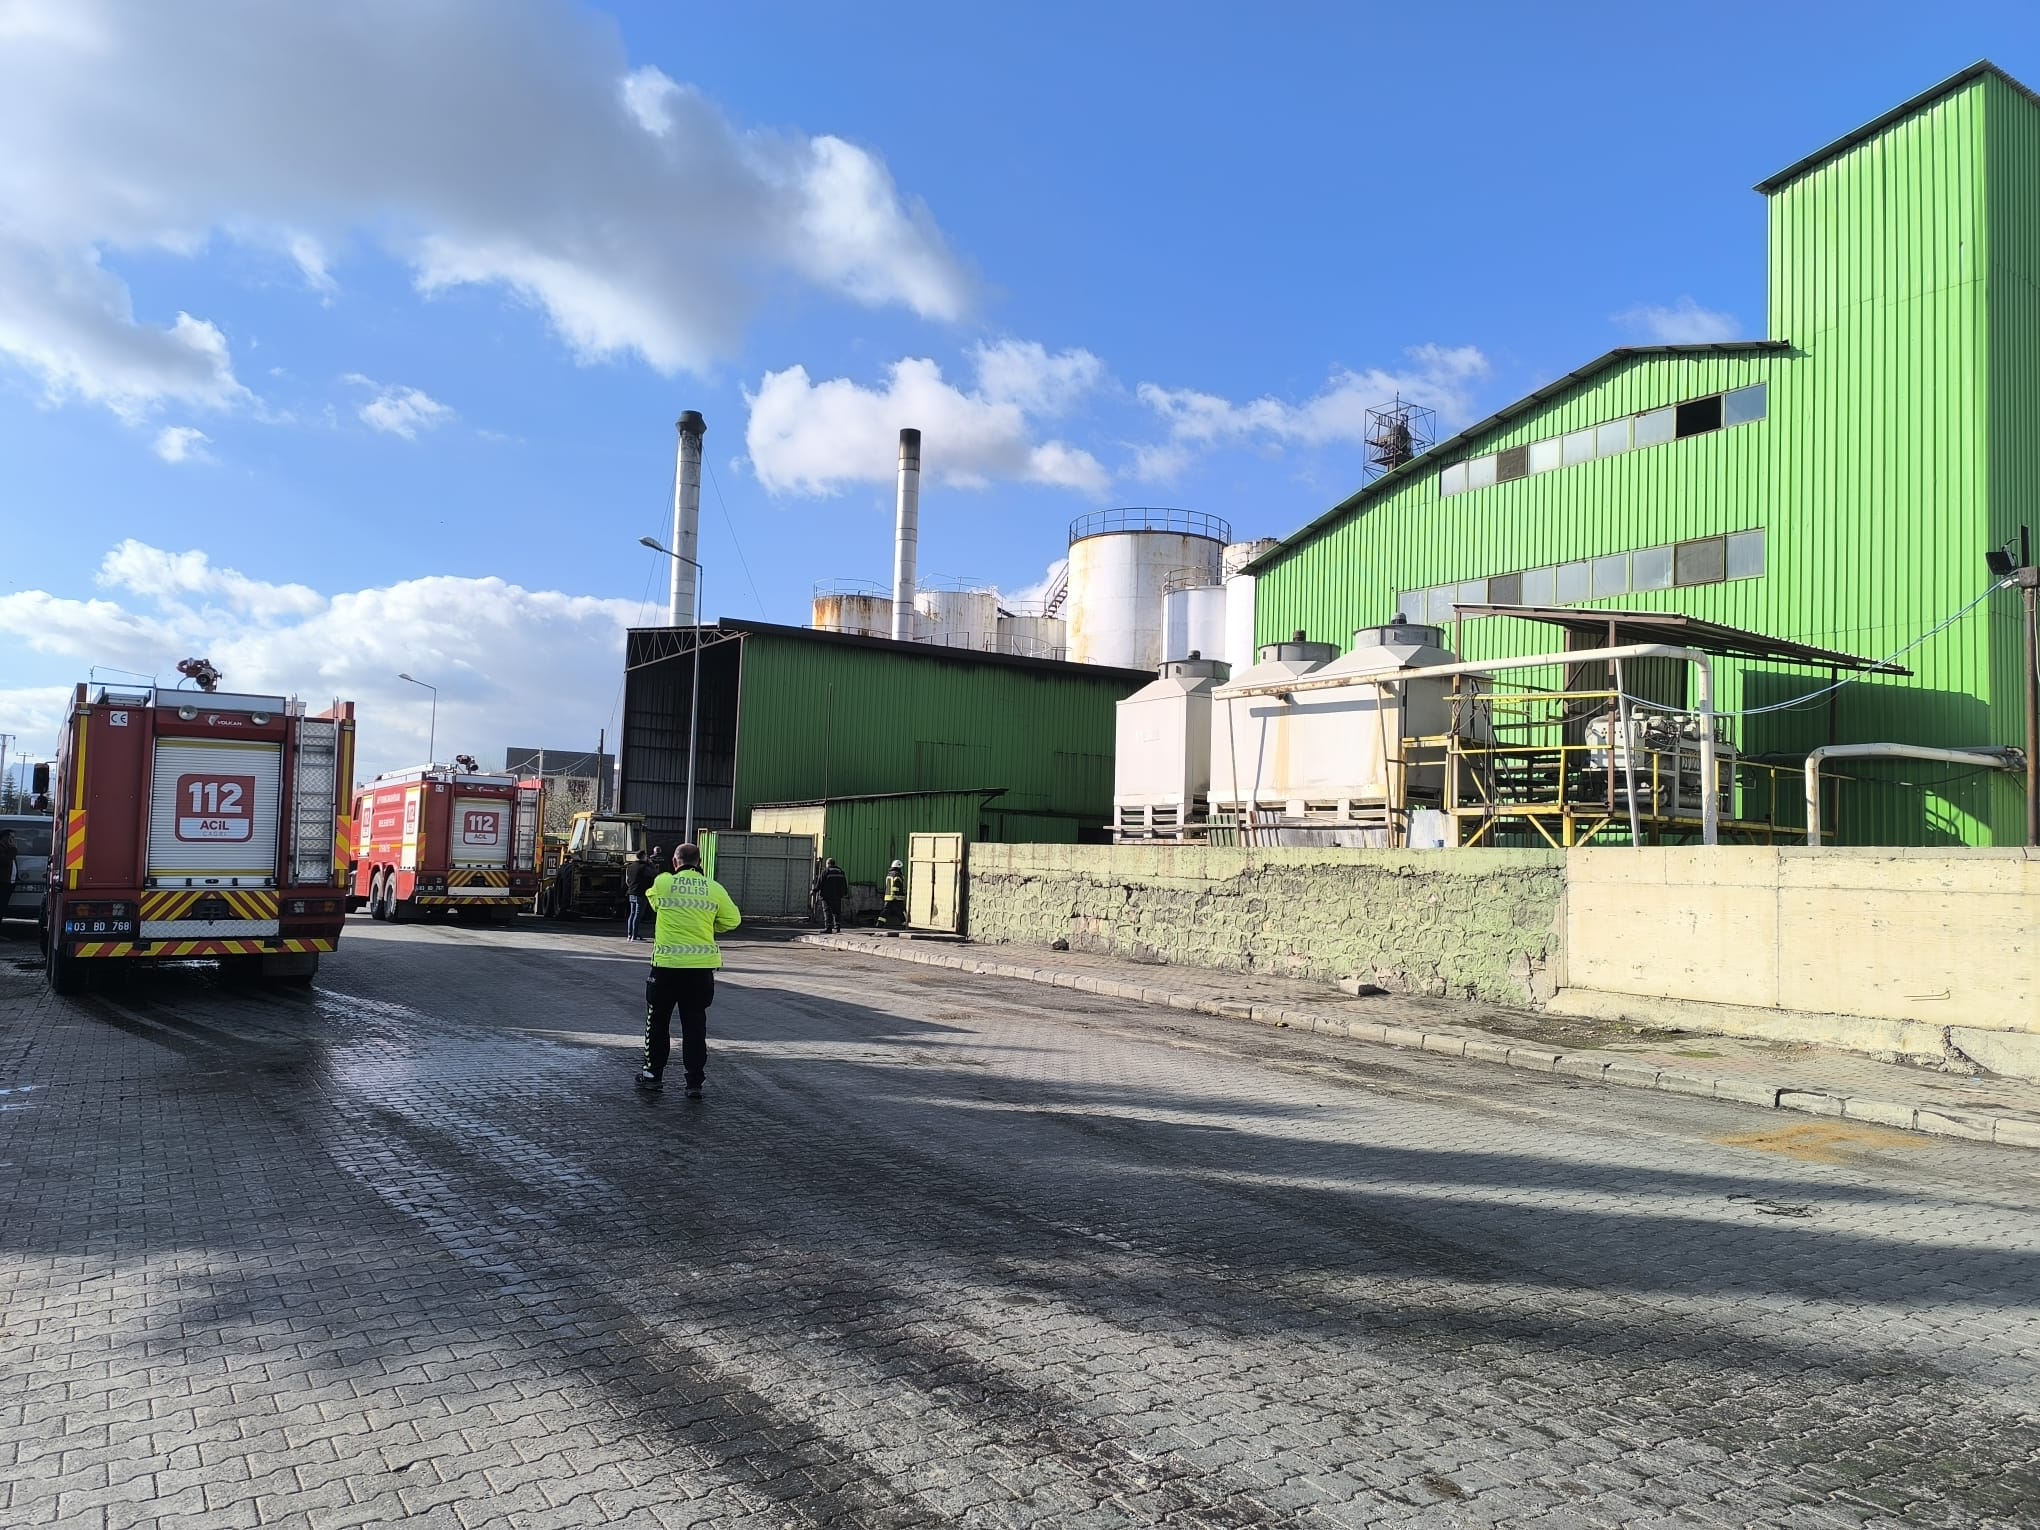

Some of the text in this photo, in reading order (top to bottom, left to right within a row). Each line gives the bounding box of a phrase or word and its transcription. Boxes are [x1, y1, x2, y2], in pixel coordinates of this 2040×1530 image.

[111, 713, 127, 724] CE
[188, 781, 243, 814] 112
[469, 815, 494, 831] 112
[74, 921, 130, 932] 03 BD 768
